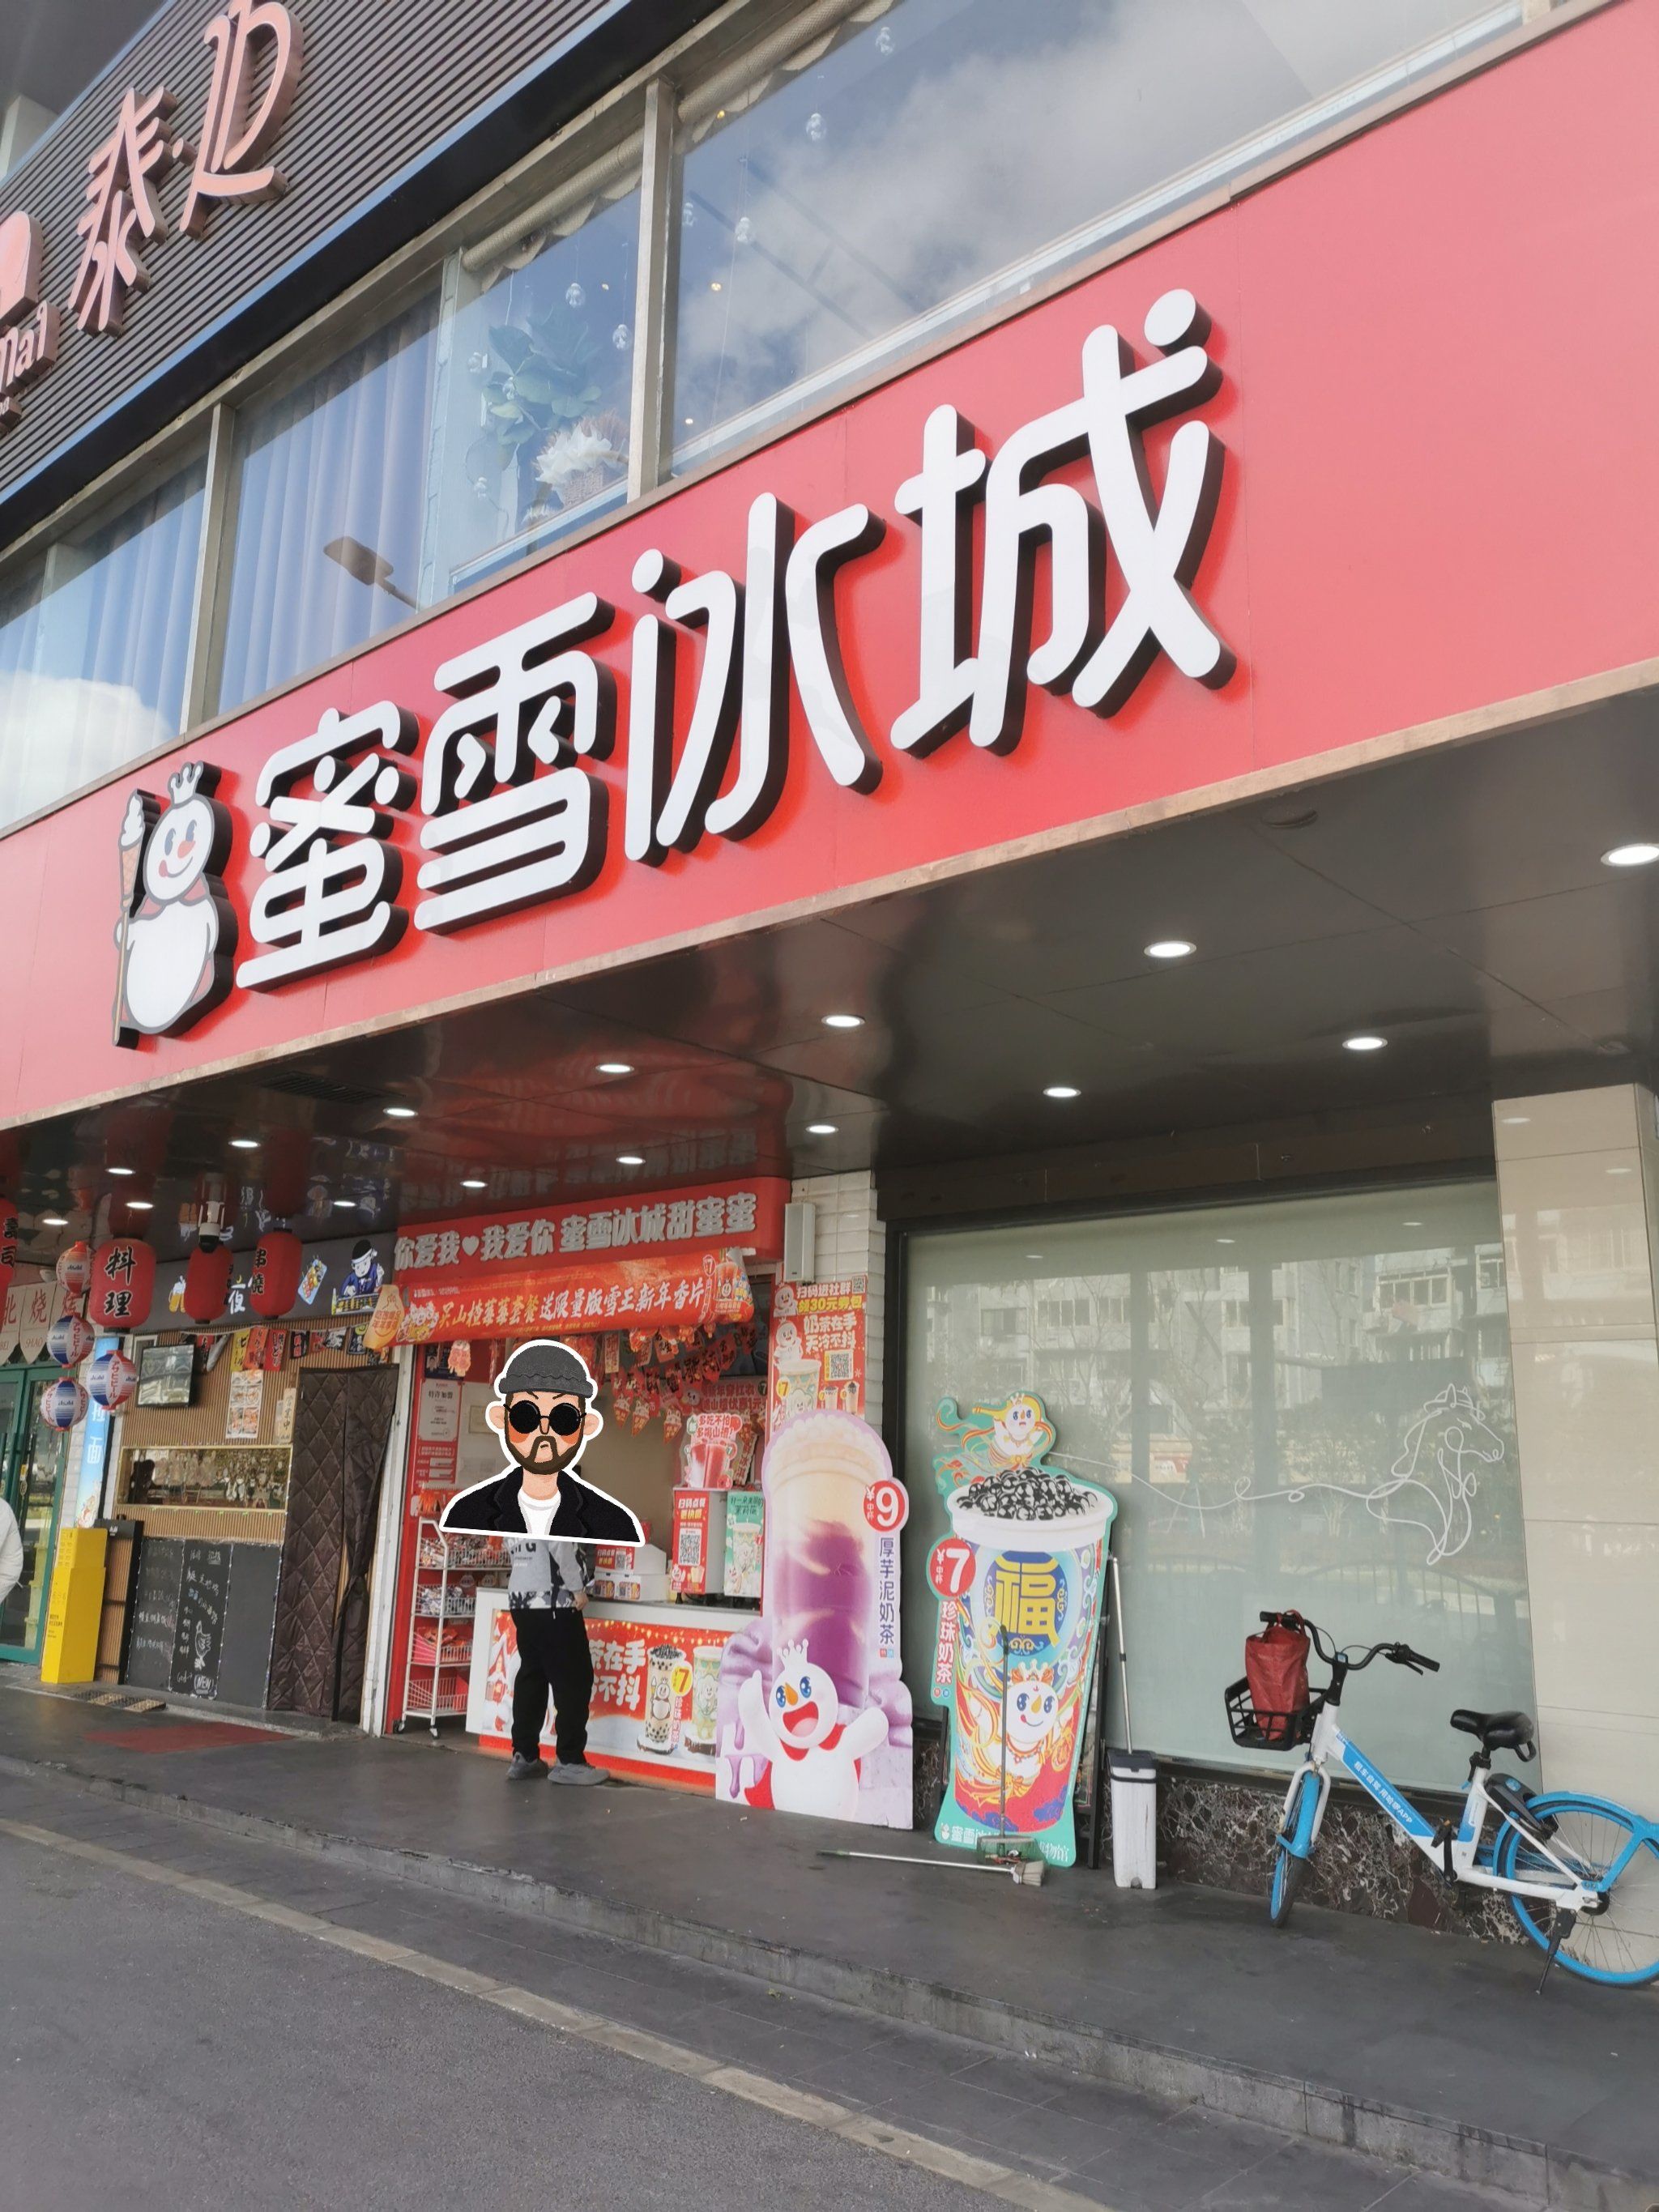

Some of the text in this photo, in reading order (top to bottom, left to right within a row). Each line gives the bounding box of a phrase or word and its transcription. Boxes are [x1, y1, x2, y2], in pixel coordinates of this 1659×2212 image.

[236, 288, 1227, 991] 蜜雪冰城
[394, 1191, 757, 1272] 你爱我 我爱你 蜜雪冰城甜蜜蜜
[104, 1246, 136, 1317] 料理
[796, 1282, 851, 1298] 扫码进社群
[804, 1312, 856, 1336] 奶茶在手
[806, 1331, 856, 1354] 天冷不抖
[699, 1414, 731, 1426] 多吃不怕
[867, 1503, 874, 1519] 中杯
[880, 1537, 894, 1645] 厚芋泥奶茶
[936, 1566, 944, 1584] 中杯
[994, 1554, 1060, 1647] 福
[936, 1600, 958, 1685] 珍珠奶茶
[673, 1695, 684, 1744] 珍珠奶茶
